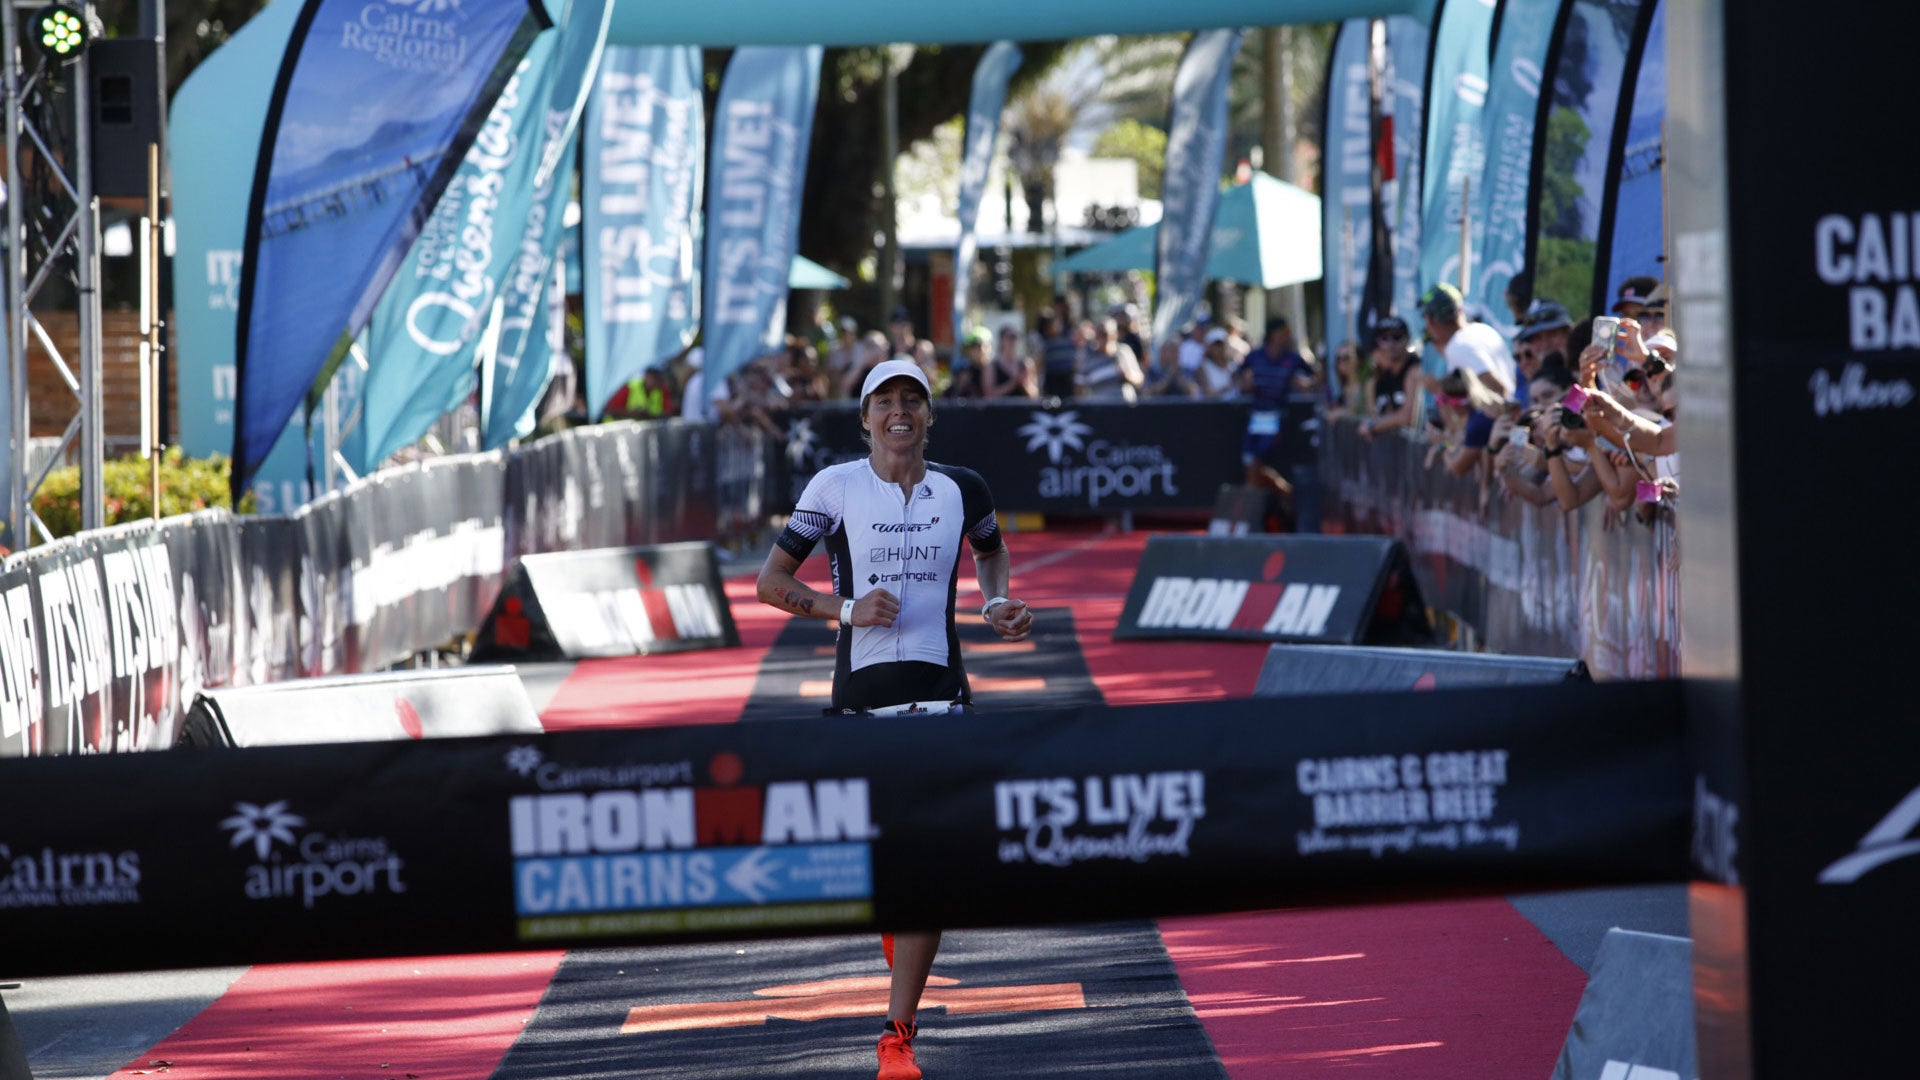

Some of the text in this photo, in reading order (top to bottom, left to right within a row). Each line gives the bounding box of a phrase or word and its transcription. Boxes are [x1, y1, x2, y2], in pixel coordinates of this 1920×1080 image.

[341, 21, 467, 64] Regional
[360, 2, 456, 39] Cairns
[600, 72, 652, 323] IT'S LIVE!
[715, 101, 774, 325] IT'S LIVE!
[1037, 454, 1178, 507] airport
[1087, 440, 1164, 468] Cairns
[888, 546, 941, 561] HUNT
[1137, 575, 1341, 636] IRONMAN
[1426, 749, 1508, 786] GREAT
[510, 778, 870, 856] IRONMAN
[995, 770, 1205, 830] IT'S LIVE!
[301, 832, 389, 863] Cairns
[245, 852, 406, 908] airport
[520, 855, 718, 912] CAIRNS
